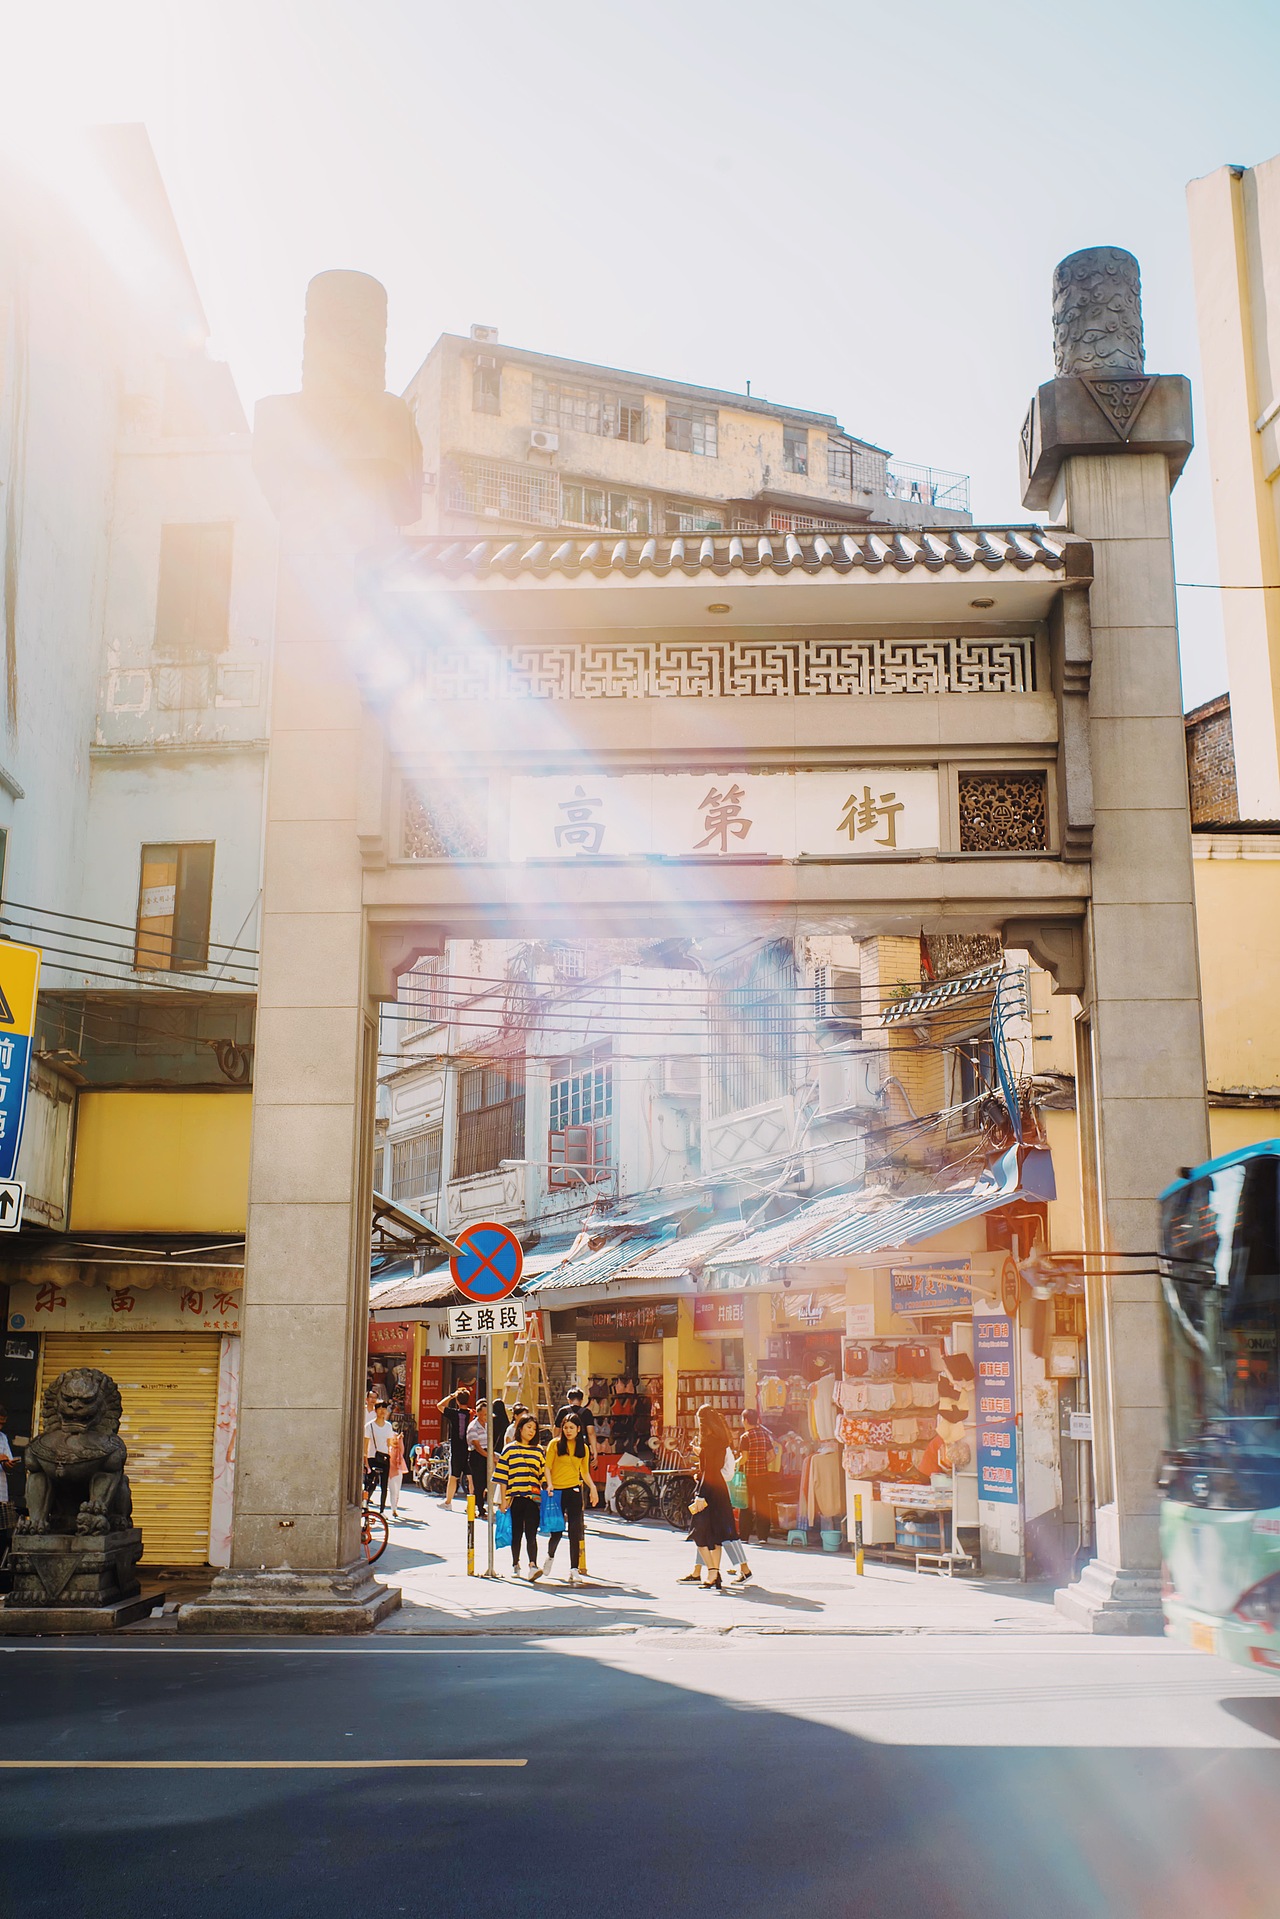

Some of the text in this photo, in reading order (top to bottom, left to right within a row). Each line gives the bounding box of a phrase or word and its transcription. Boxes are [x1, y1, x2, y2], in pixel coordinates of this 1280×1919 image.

[553, 783, 905, 853] 高第街
[455, 1307, 518, 1333] 全路段
[978, 1322, 1009, 1338] 工厂直销
[983, 1466, 1013, 1484] 批发零售
